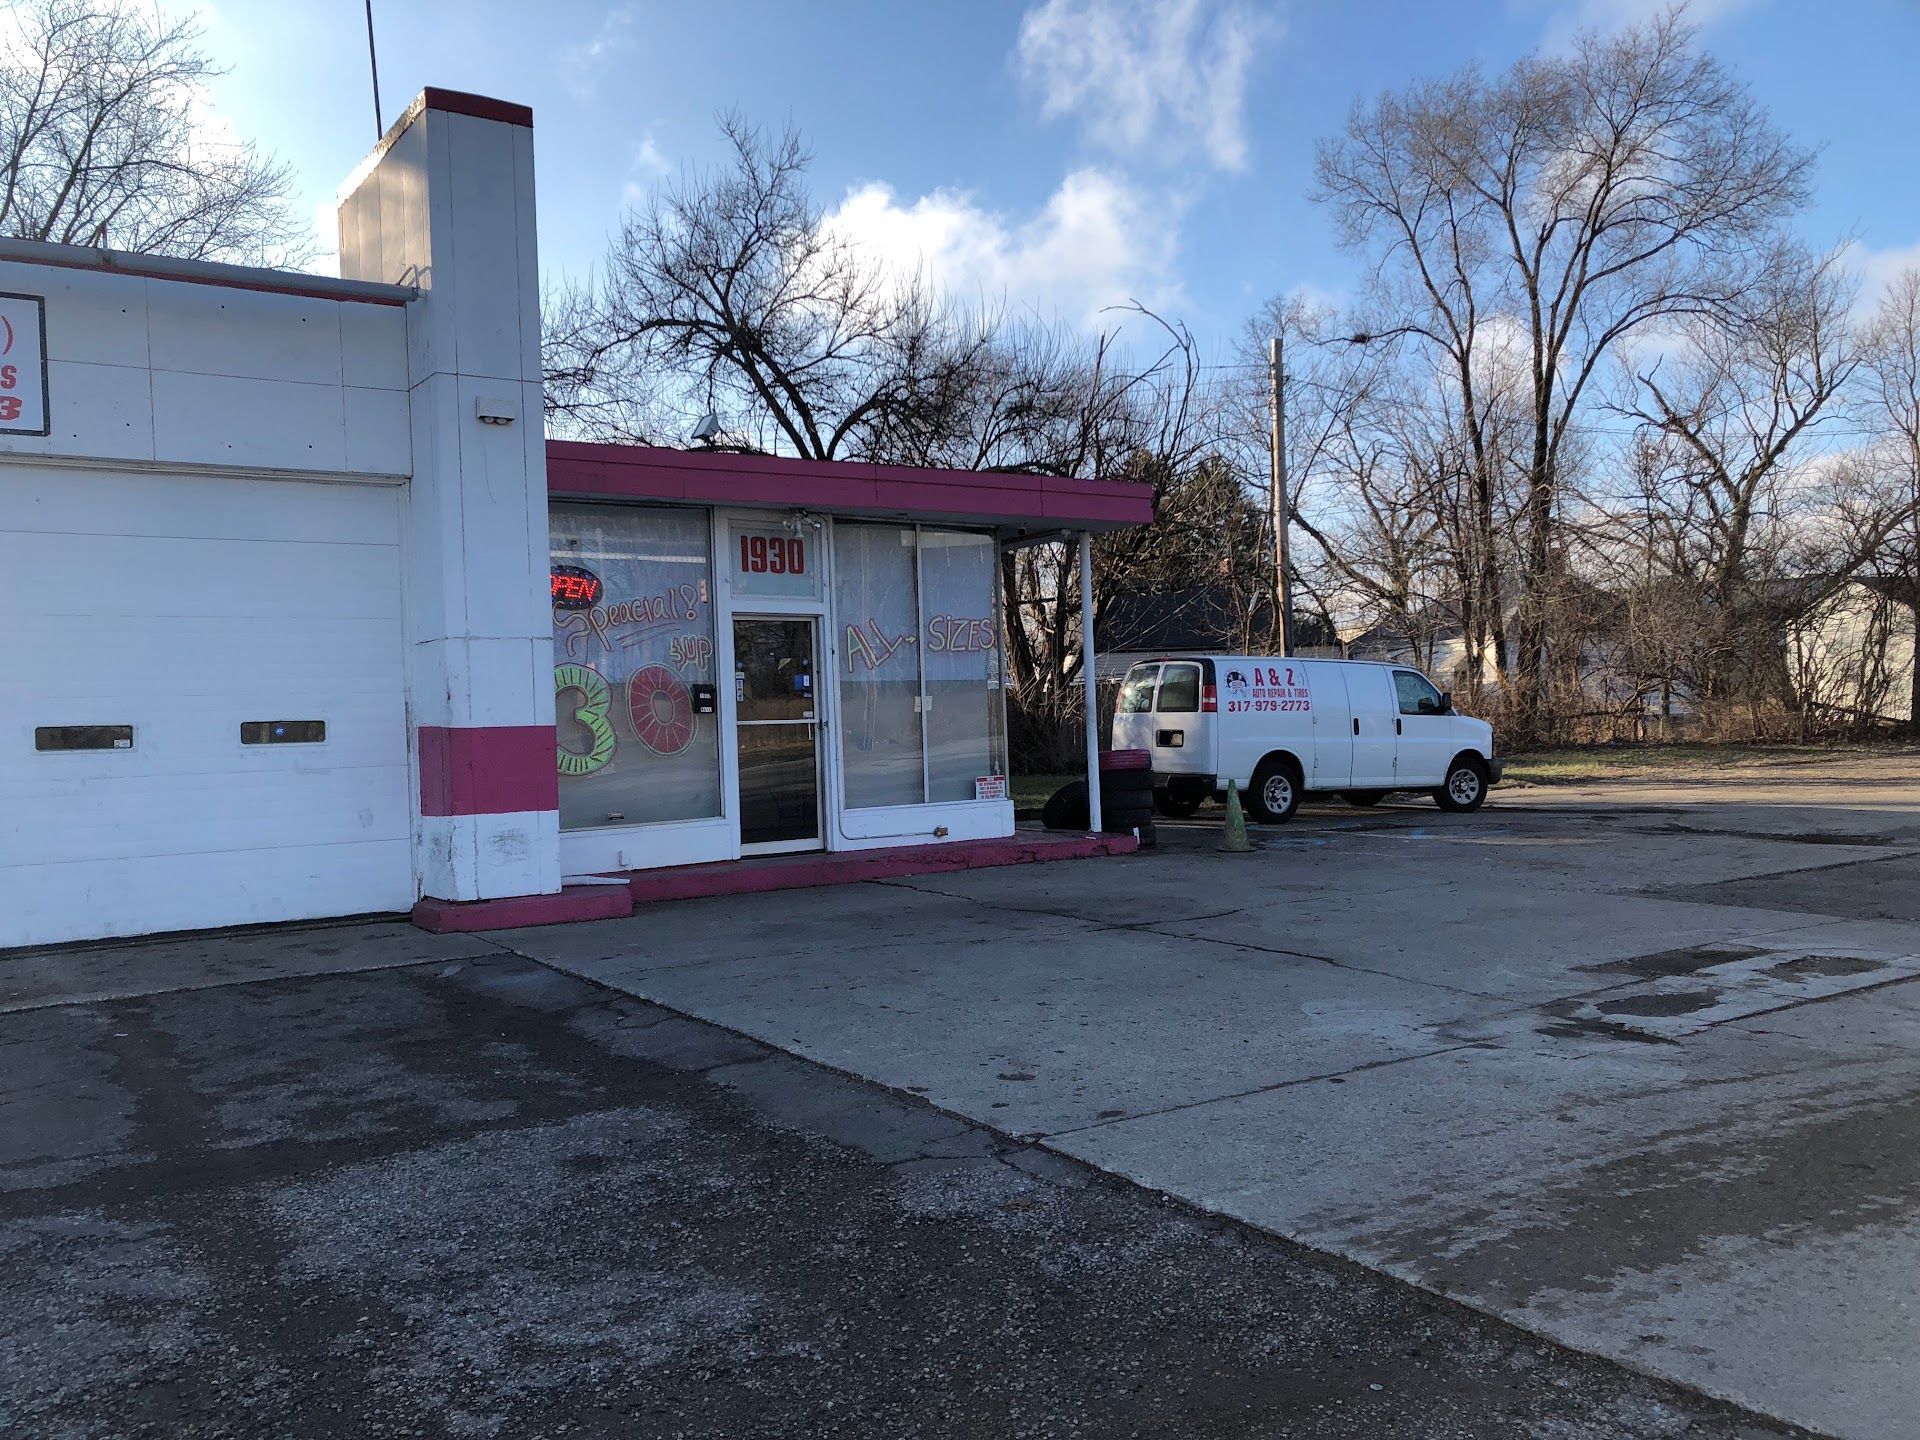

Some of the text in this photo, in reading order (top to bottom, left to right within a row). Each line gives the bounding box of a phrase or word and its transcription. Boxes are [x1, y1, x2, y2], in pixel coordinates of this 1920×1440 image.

[740, 535, 805, 574] 1930
[1254, 667, 1295, 687] A & Z
[1252, 688, 1309, 698] AUTO REPAIR & TIRES
[1228, 700, 1310, 712] 317-979-2773
